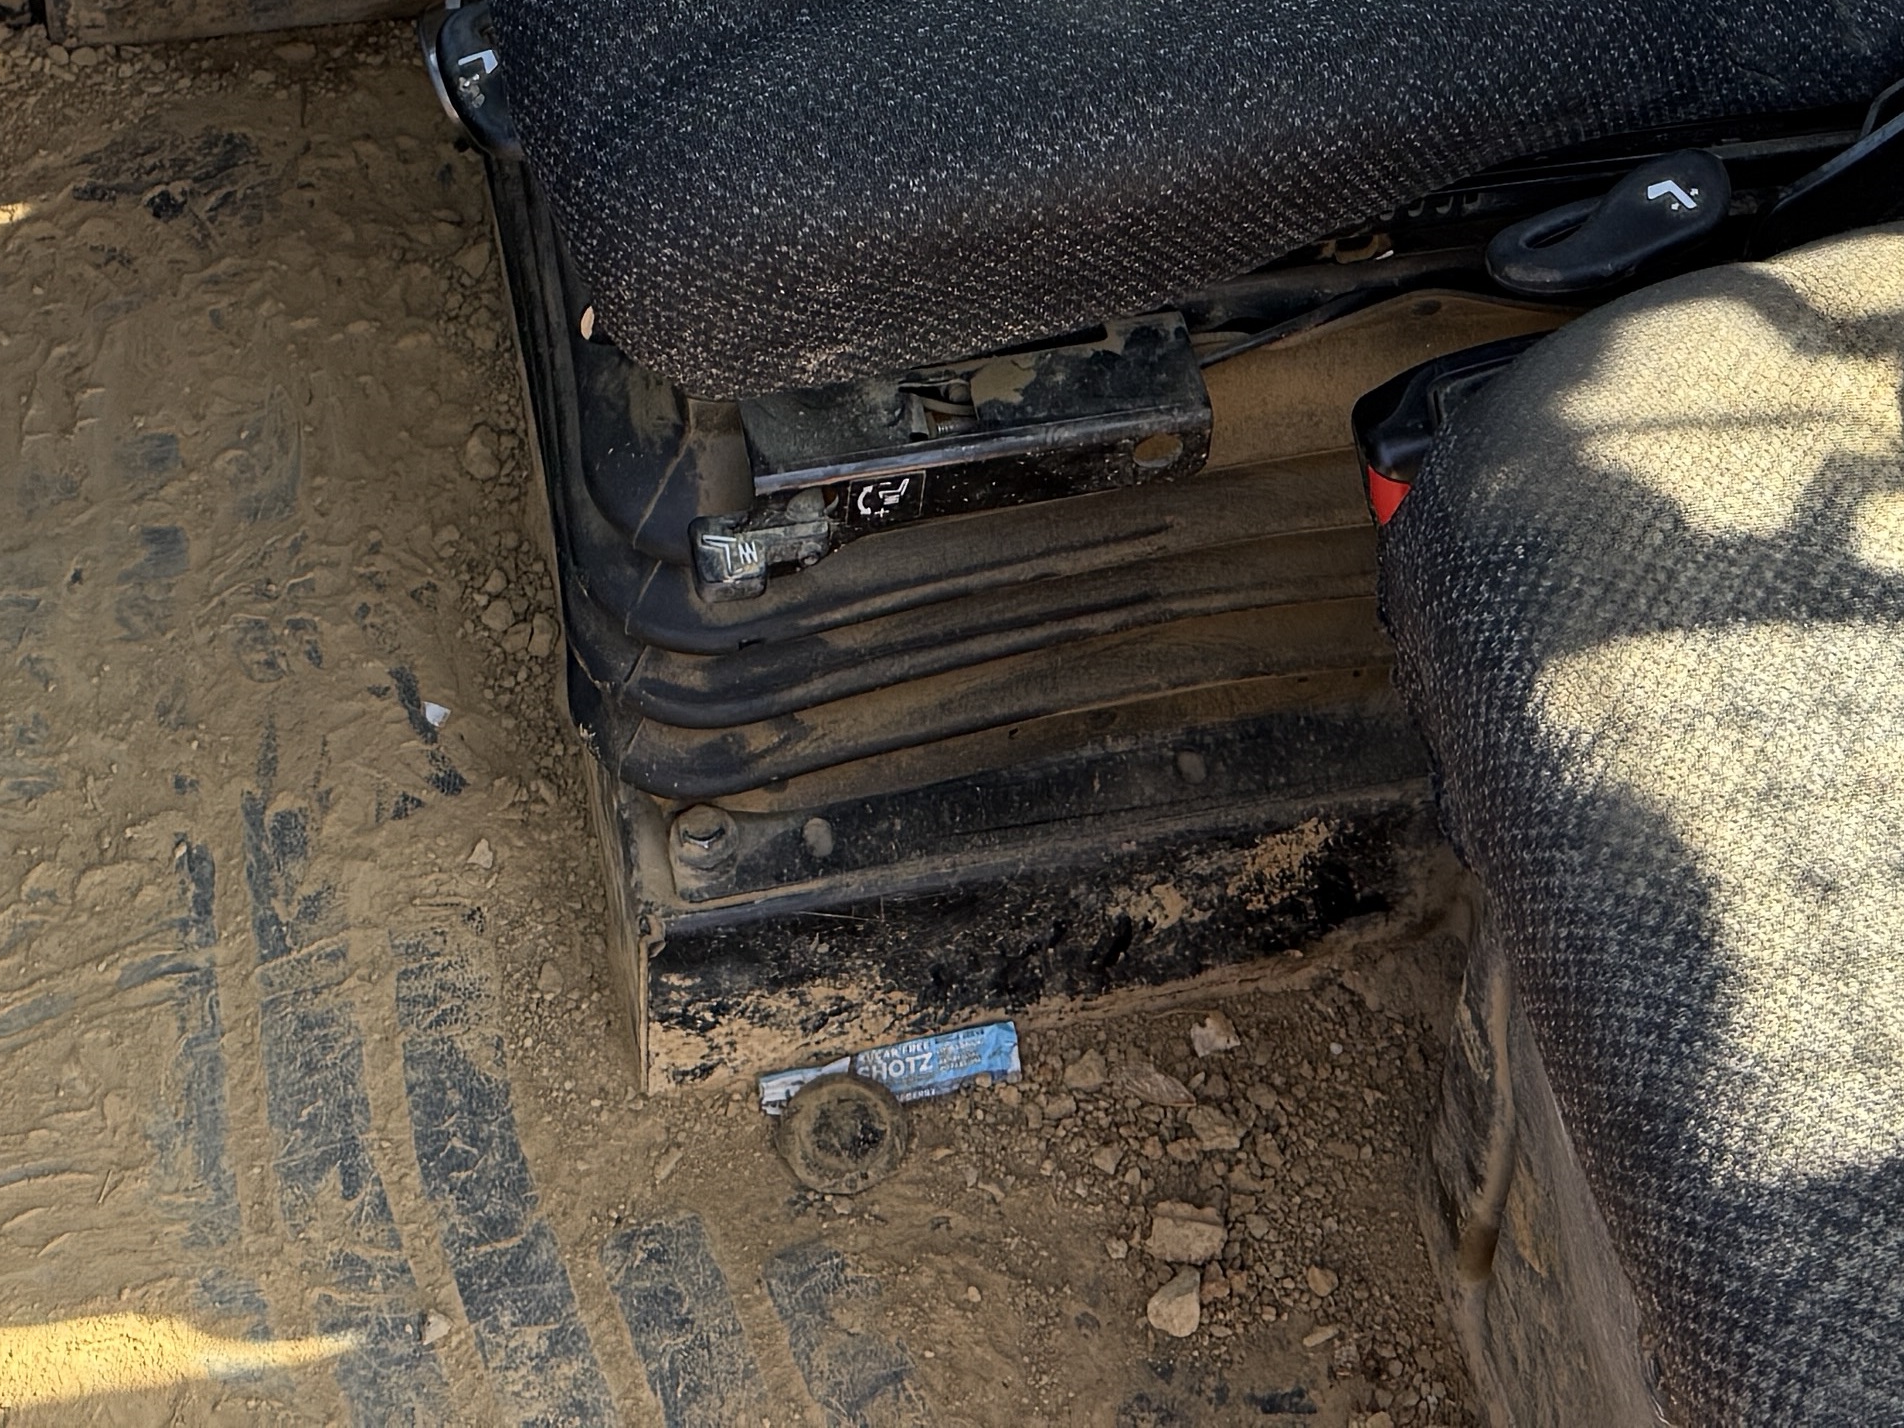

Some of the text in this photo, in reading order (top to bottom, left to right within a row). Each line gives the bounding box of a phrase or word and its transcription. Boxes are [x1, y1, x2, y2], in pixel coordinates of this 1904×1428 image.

[857, 1040, 931, 1063] SUGAR FREE
[857, 1052, 933, 1081] SHOTZ
